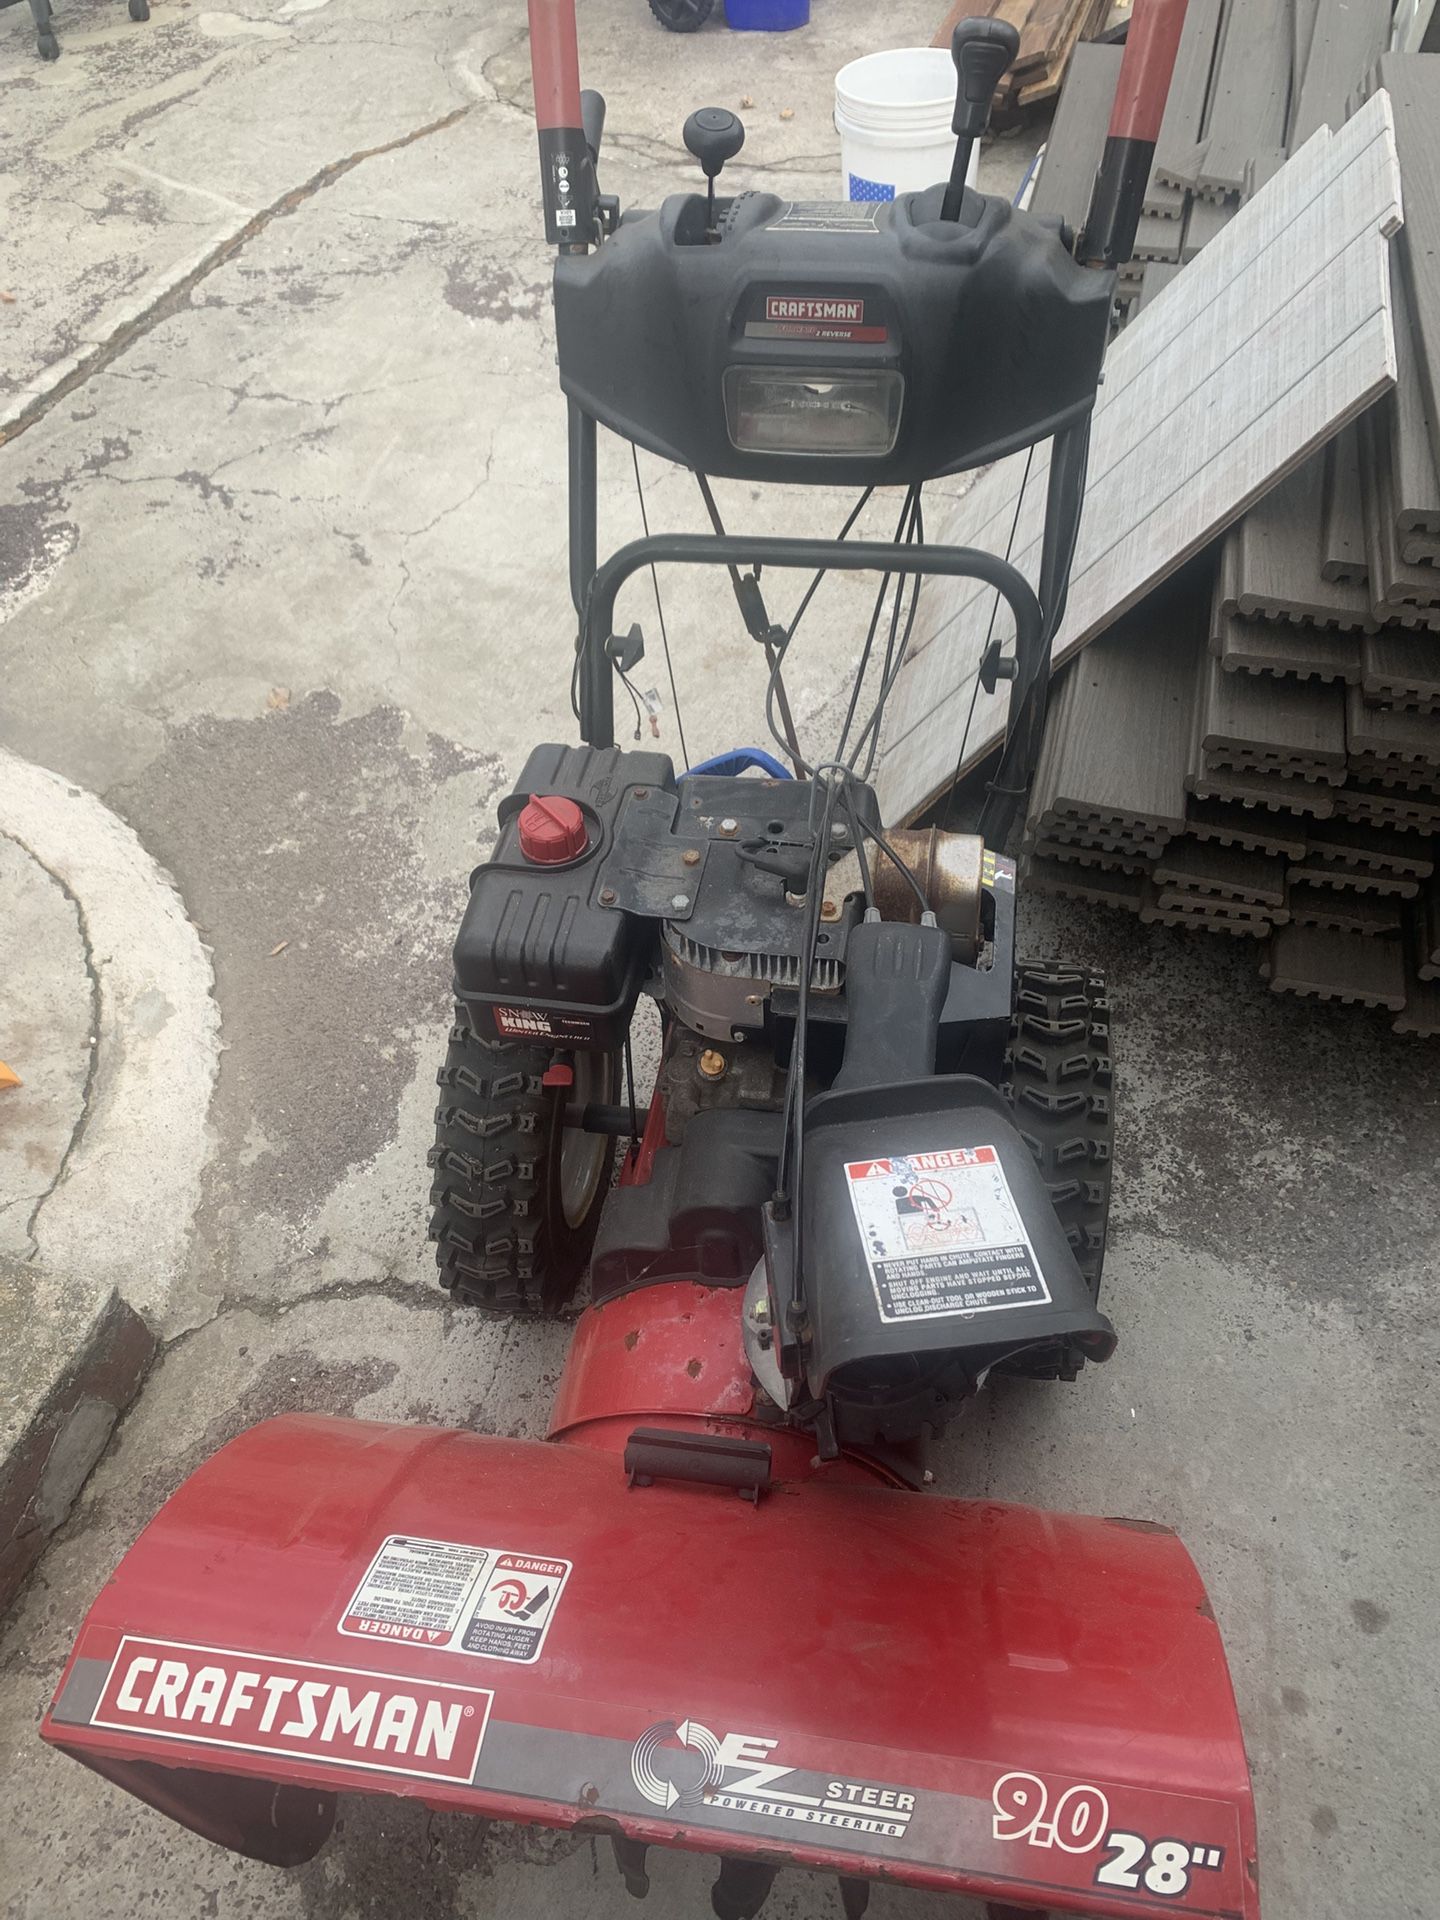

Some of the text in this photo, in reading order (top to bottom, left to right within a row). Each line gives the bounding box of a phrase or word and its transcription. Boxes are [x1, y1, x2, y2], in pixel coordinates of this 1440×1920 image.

[821, 330, 852, 338] REVERSE
[500, 1016, 551, 1032] KING
[886, 1149, 978, 1173] ANGER
[883, 1260, 905, 1268] NEVER
[972, 1249, 1004, 1257] CONTACT
[884, 1265, 918, 1274] ROTATING
[957, 1256, 994, 1265] AMPUTATE
[994, 1252, 1025, 1260] FINGERS
[887, 1280, 908, 1288] SHUT
[925, 1274, 952, 1283] ENGINE
[953, 1272, 970, 1280] AND
[991, 1267, 1013, 1275] UNTIL
[889, 1271, 1031, 1294] MOVING PARTS HAVE STOPPED BEFORE
[906, 1296, 944, 1306] CLEAN-OUT
[945, 1294, 963, 1302] TOOL
[975, 1289, 1005, 1298] WOODEN
[1005, 1286, 1026, 1294] STICK
[894, 1306, 923, 1315] UNCLOG
[923, 1301, 963, 1311] DISCHARGE
[514, 1559, 563, 1573] DANGER
[357, 1619, 423, 1639] DANGER
[472, 1628, 506, 1638] ROTATING
[506, 1634, 530, 1642] AUGER
[474, 1622, 536, 1636] AVOID INJURY FROM
[469, 1635, 487, 1643] KEEP
[513, 1642, 530, 1650] FEET
[479, 1644, 509, 1654] CLOTHING
[712, 1732, 916, 1811] EZ STEER
[709, 1795, 899, 1834] POWERED STEERING
[992, 1771, 1110, 1854] 9.0
